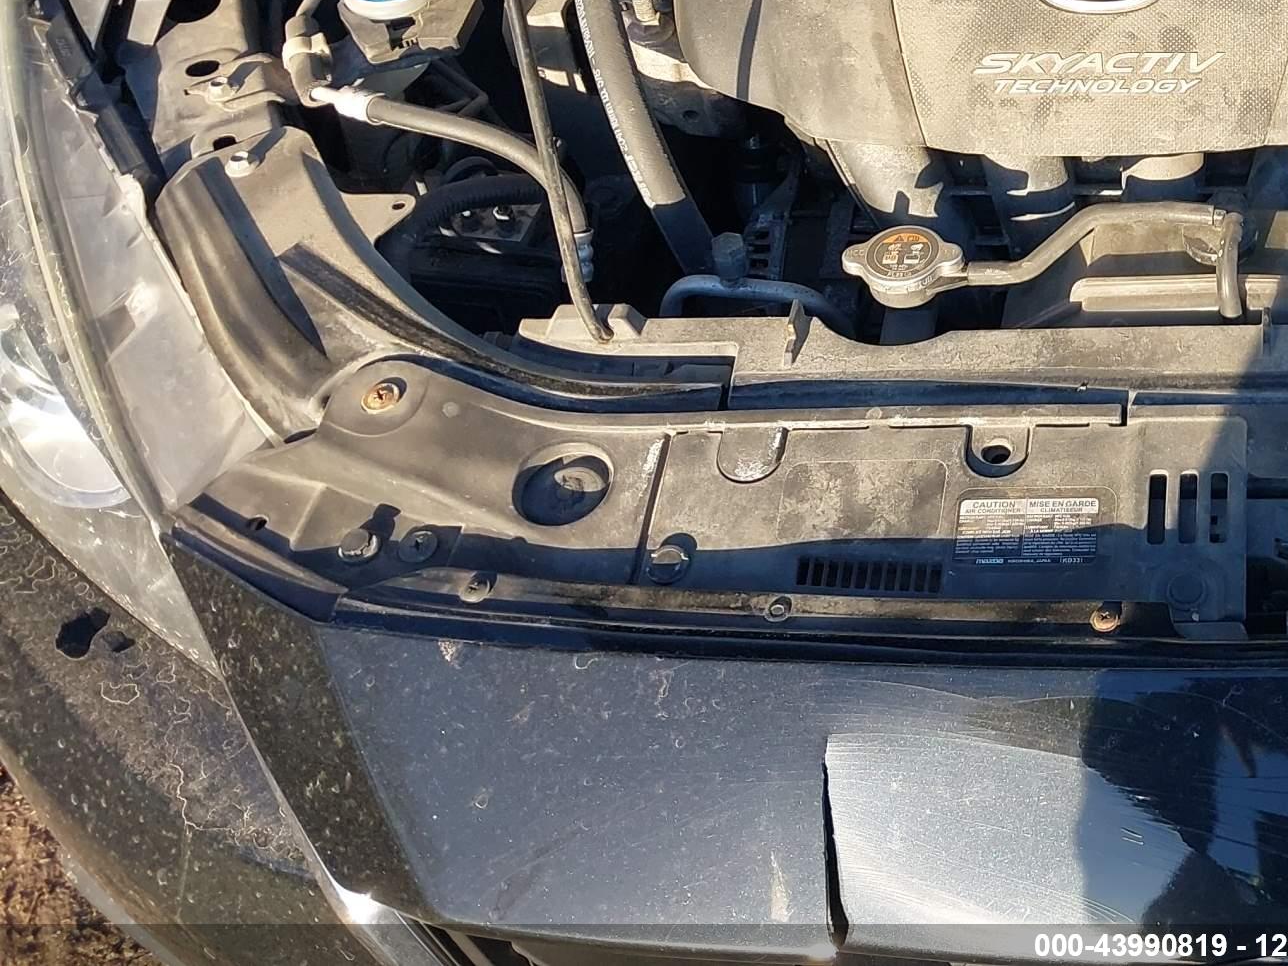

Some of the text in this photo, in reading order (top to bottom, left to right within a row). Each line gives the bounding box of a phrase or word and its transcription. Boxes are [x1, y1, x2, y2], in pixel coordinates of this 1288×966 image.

[973, 51, 1226, 75] SKYACTIV
[994, 78, 1202, 95] TECHNOLOGY
[972, 501, 1016, 509] CAUTION
